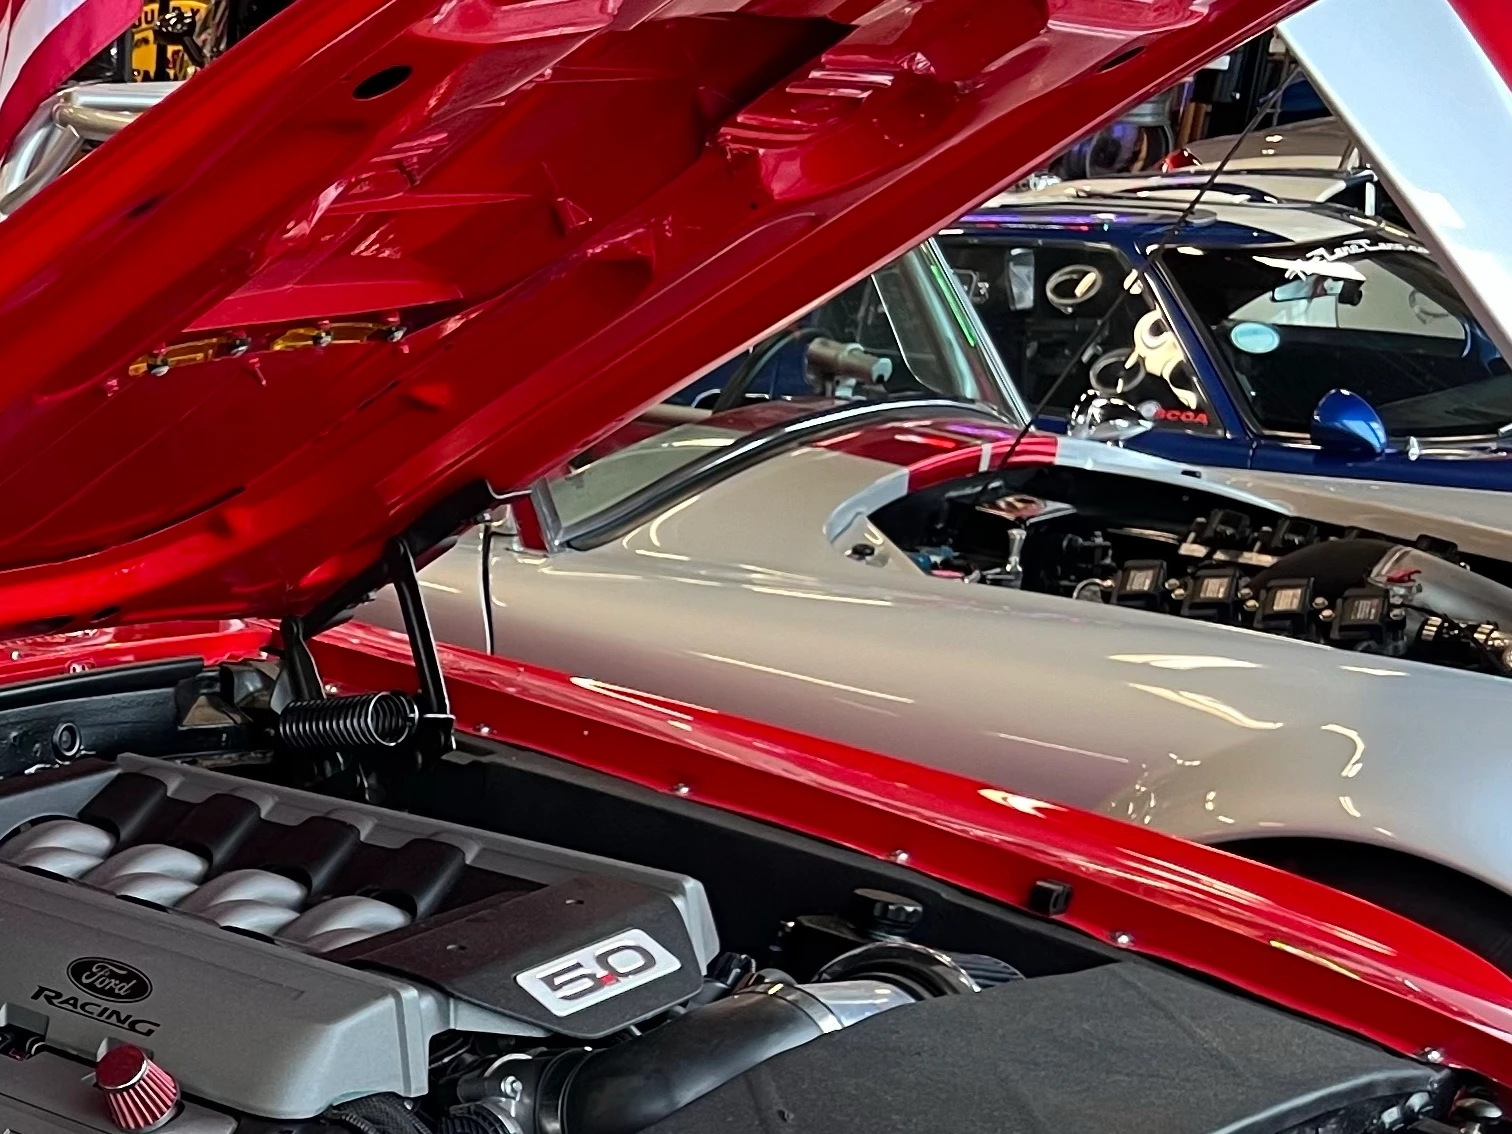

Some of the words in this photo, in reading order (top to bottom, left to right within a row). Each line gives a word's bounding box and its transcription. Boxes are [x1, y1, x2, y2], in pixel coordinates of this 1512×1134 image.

[81, 962, 137, 996] Ford
[538, 945, 656, 1000] 5.0
[30, 984, 161, 1037] RACING
